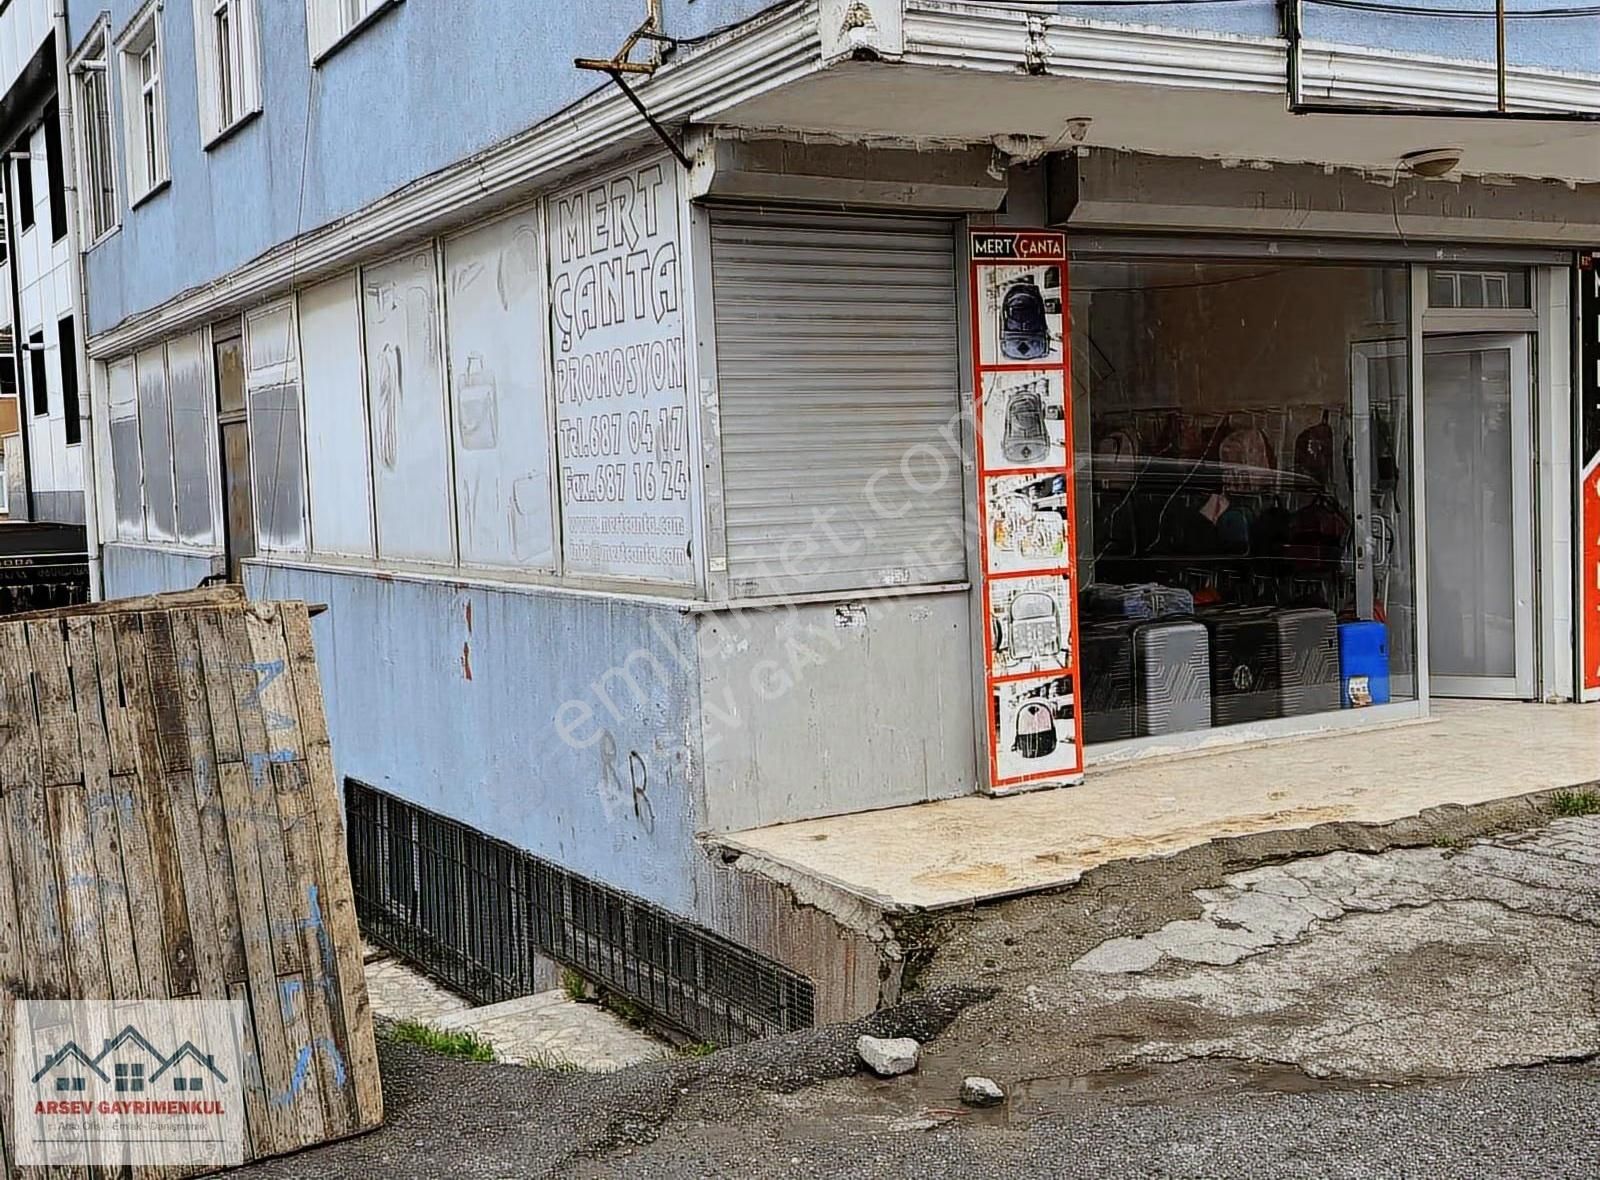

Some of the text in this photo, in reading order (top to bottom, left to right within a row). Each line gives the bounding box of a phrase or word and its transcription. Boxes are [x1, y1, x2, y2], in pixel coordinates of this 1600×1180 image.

[558, 164, 663, 264] MERT
[975, 239, 1062, 258] MERT ÇANTA
[554, 241, 678, 352] ÇANTA
[557, 337, 683, 406] PROMOSYON
[560, 406, 684, 459] Tel.687 04 17
[563, 460, 687, 506] Fax.687 16 24
